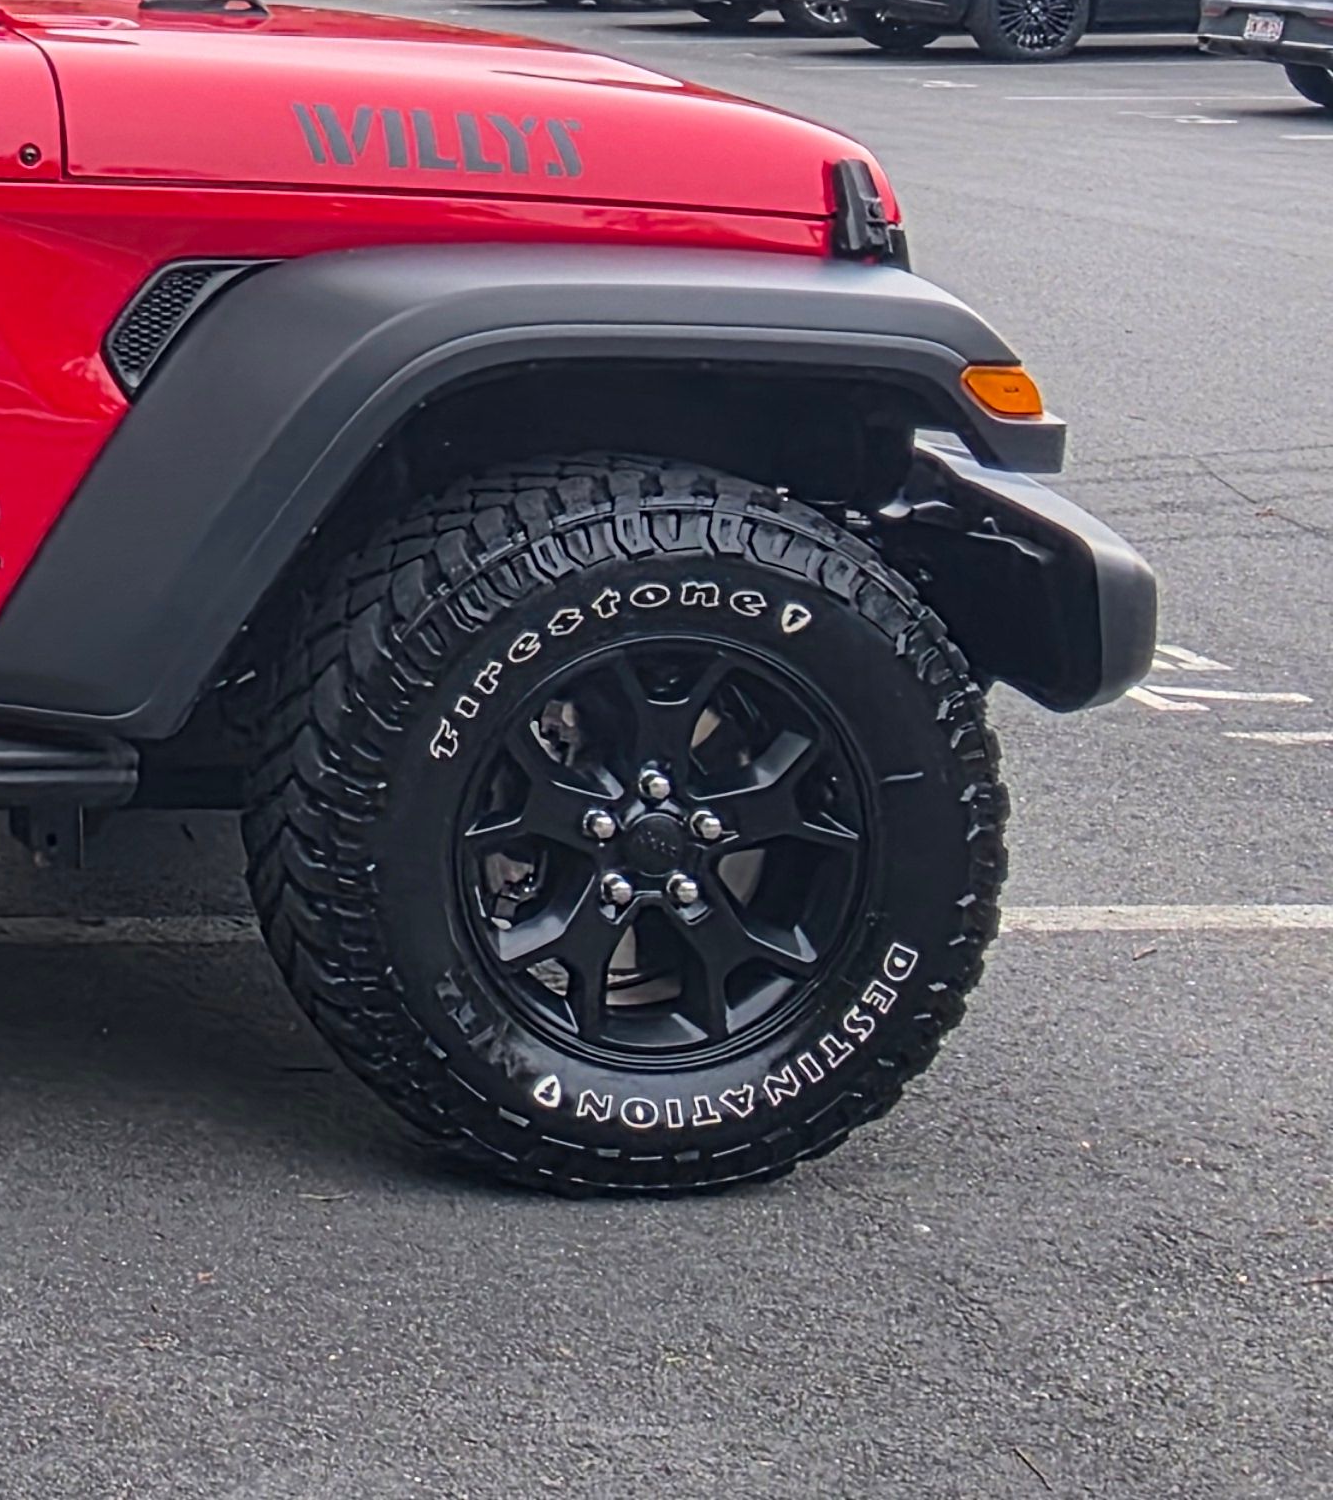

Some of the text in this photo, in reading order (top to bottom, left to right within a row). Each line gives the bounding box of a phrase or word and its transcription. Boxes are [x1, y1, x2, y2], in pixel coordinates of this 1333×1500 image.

[292, 102, 583, 178] WILLYS
[429, 581, 768, 761] Firestone
[576, 942, 918, 1128] DESTINATION
